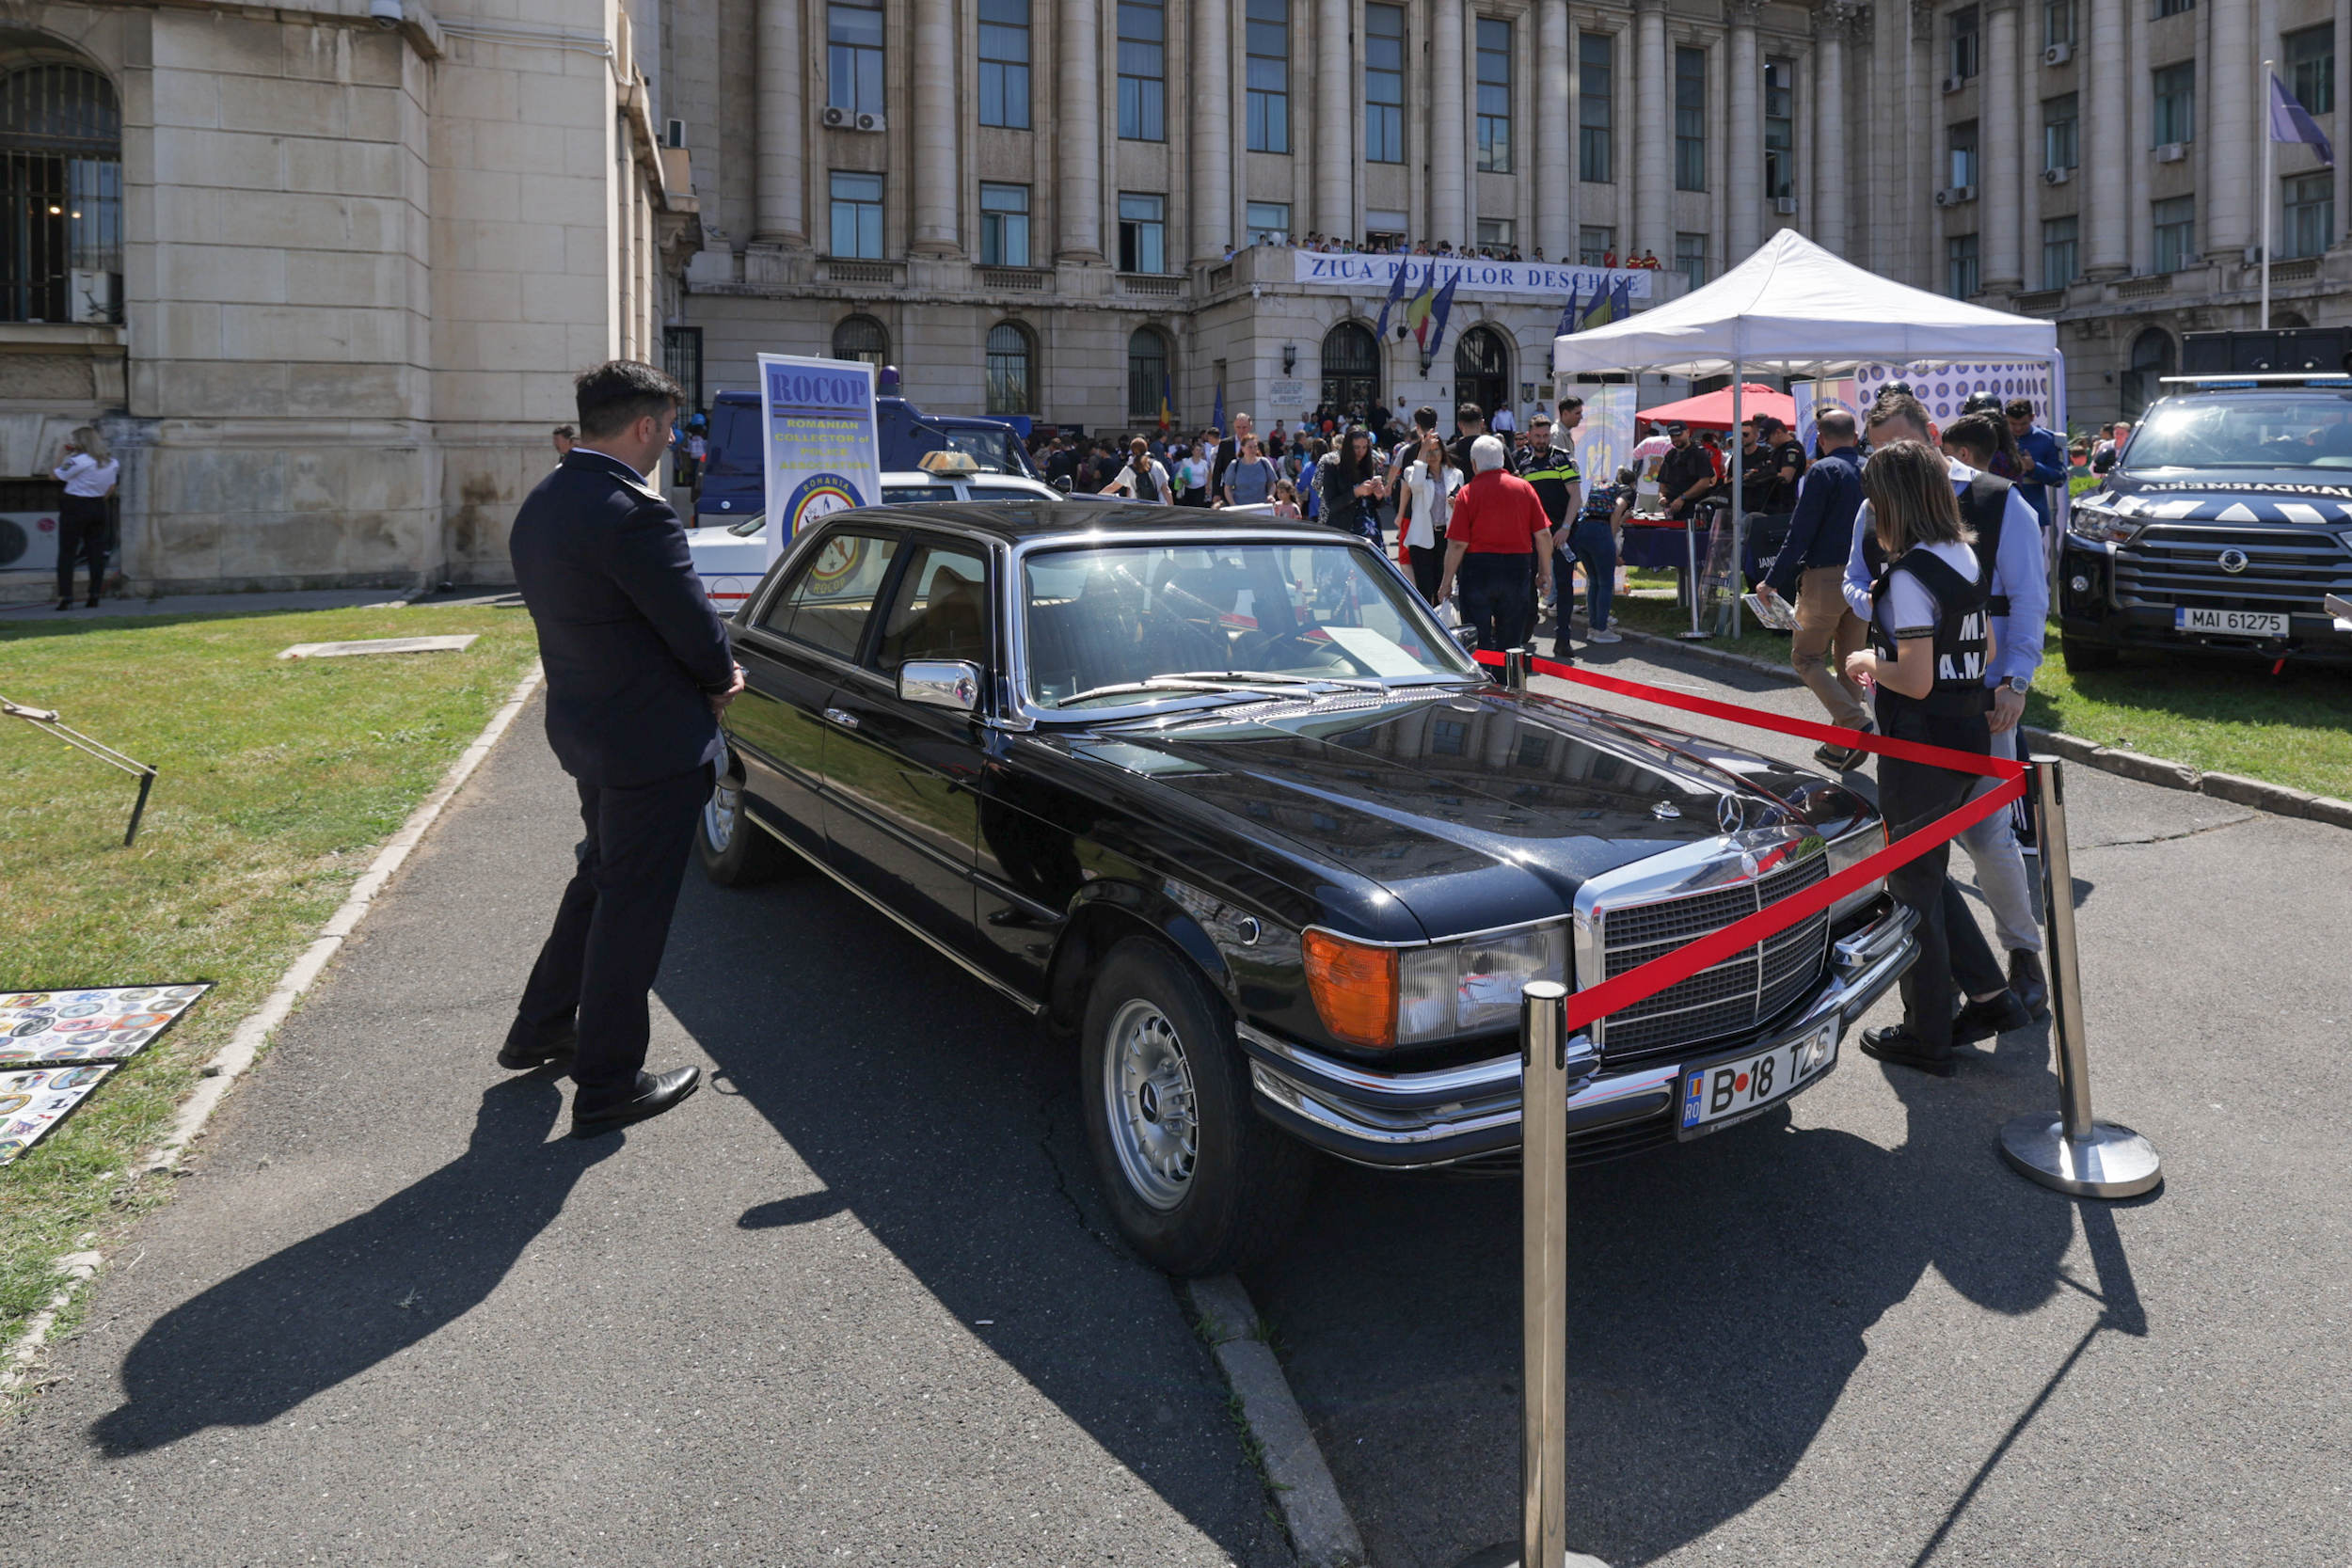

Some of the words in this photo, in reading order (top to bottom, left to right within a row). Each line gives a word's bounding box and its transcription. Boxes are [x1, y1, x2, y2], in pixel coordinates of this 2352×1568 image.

[1312, 259, 1374, 278] ZIUA
[1528, 269, 1639, 292] DESCHSE
[771, 373, 866, 405] ROCOP
[787, 420, 859, 430] ROMANIAN
[775, 433, 855, 443] COLLECTOR
[801, 448, 849, 456] POLICE
[780, 461, 870, 470] ASSOCIATION
[803, 477, 849, 492] ROMANIA
[813, 578, 846, 594] ROCOP
[2192, 610, 2220, 627] MAI
[2228, 613, 2281, 631] 61275
[1710, 1069, 1736, 1115] B
[1749, 1055, 1775, 1102] 18
[1789, 1024, 1830, 1085] TZS
[1684, 1101, 1700, 1121] RO
